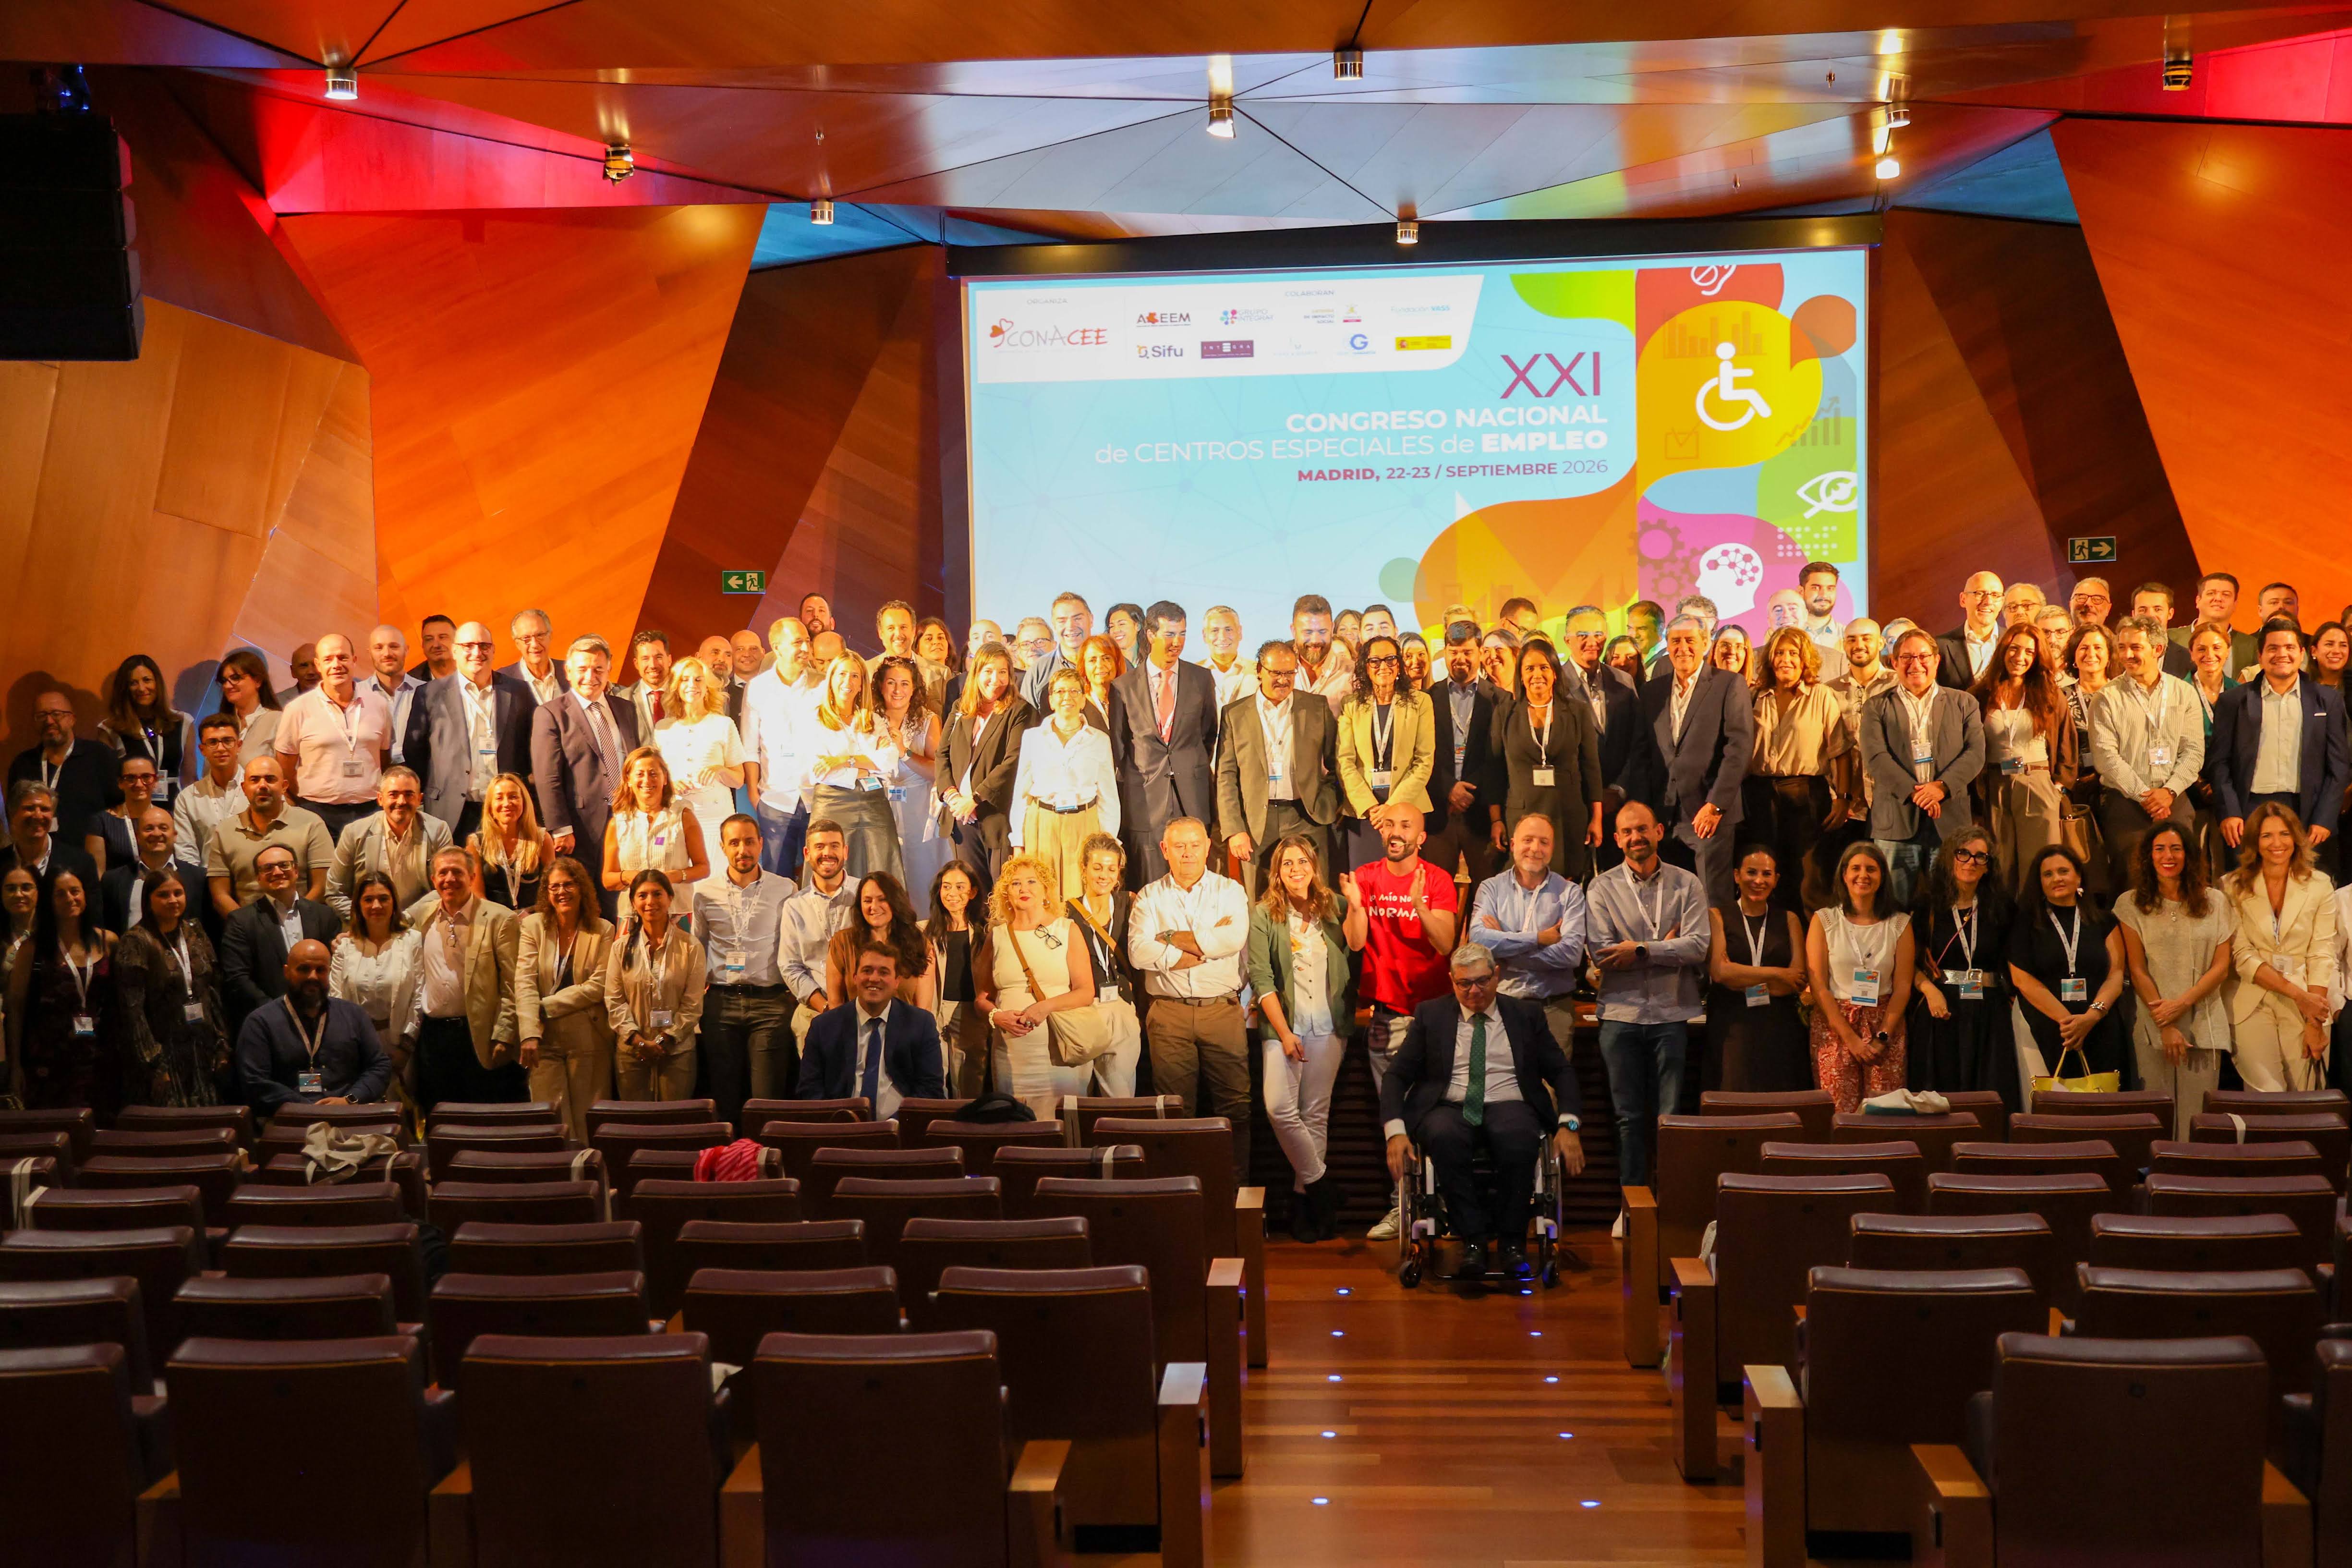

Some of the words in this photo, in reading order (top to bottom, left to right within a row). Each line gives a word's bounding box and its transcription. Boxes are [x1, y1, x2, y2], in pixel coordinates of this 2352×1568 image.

[1152, 345, 1183, 357] Sifu
[1501, 352, 1600, 399] XXI
[1285, 410, 1447, 433] CONGRESO
[1455, 404, 1609, 427] NACIONAL
[1094, 444, 1128, 463] de
[1134, 440, 1264, 462] CENTROS
[1272, 435, 1434, 459] ESPECIALES
[1441, 432, 1475, 453] de
[1481, 429, 1609, 452] EMPLEO
[1298, 468, 1380, 482] MADRID,
[1387, 467, 1431, 479] 22-23
[1435, 465, 1442, 479] /
[1446, 463, 1557, 477] SEPTIEMBRE
[1563, 460, 1609, 474] 2026
